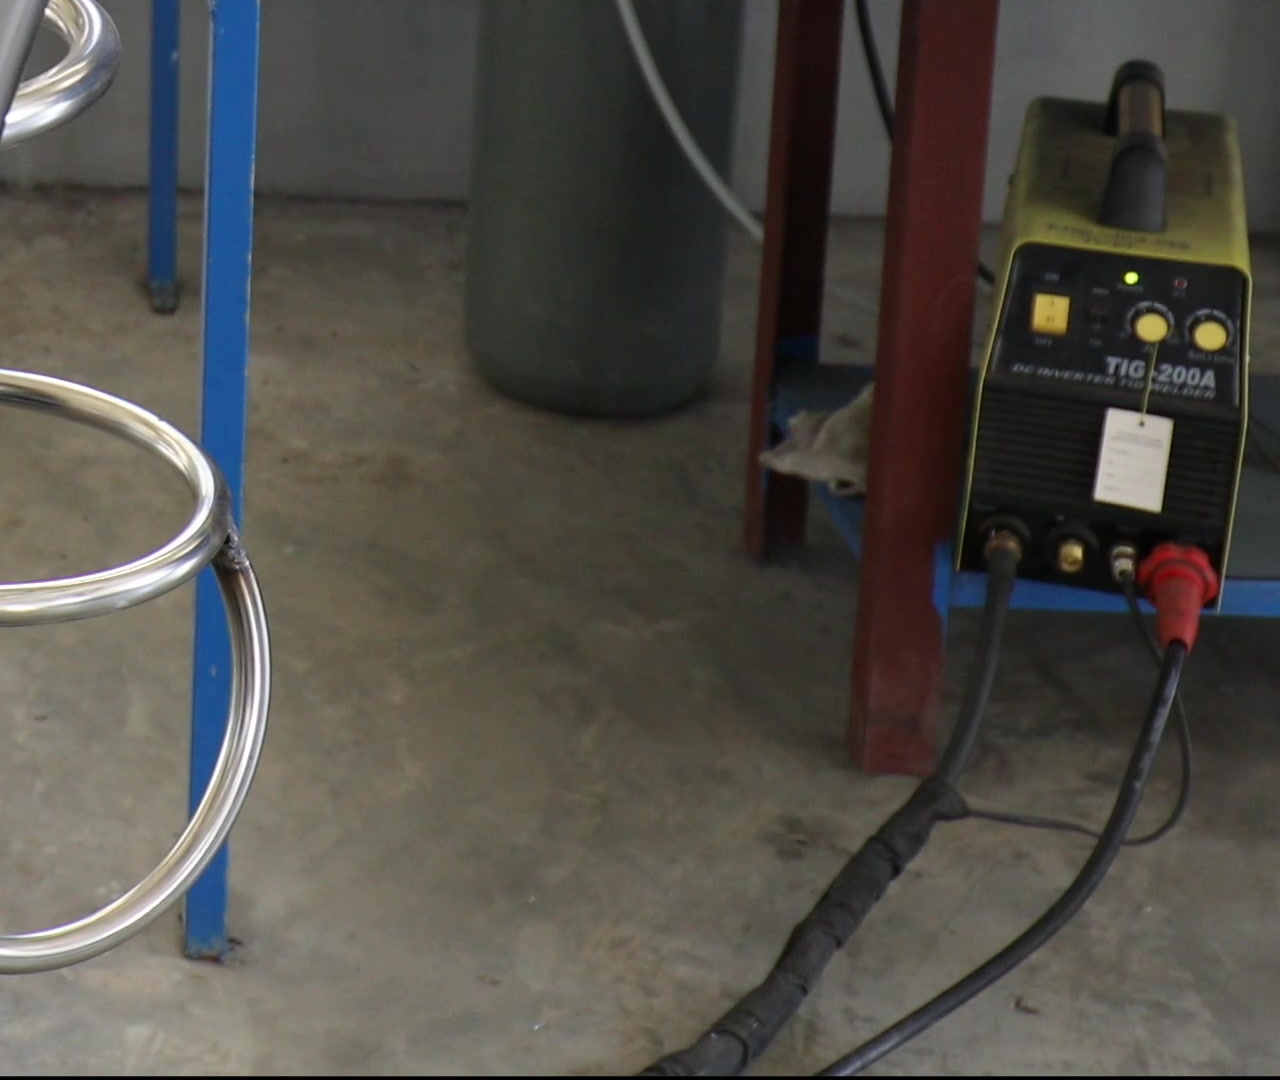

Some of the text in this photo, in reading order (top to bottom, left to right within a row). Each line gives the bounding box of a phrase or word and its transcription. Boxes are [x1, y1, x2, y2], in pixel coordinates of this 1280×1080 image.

[1011, 363, 1216, 400] DC INVERTER TIG WELDER
